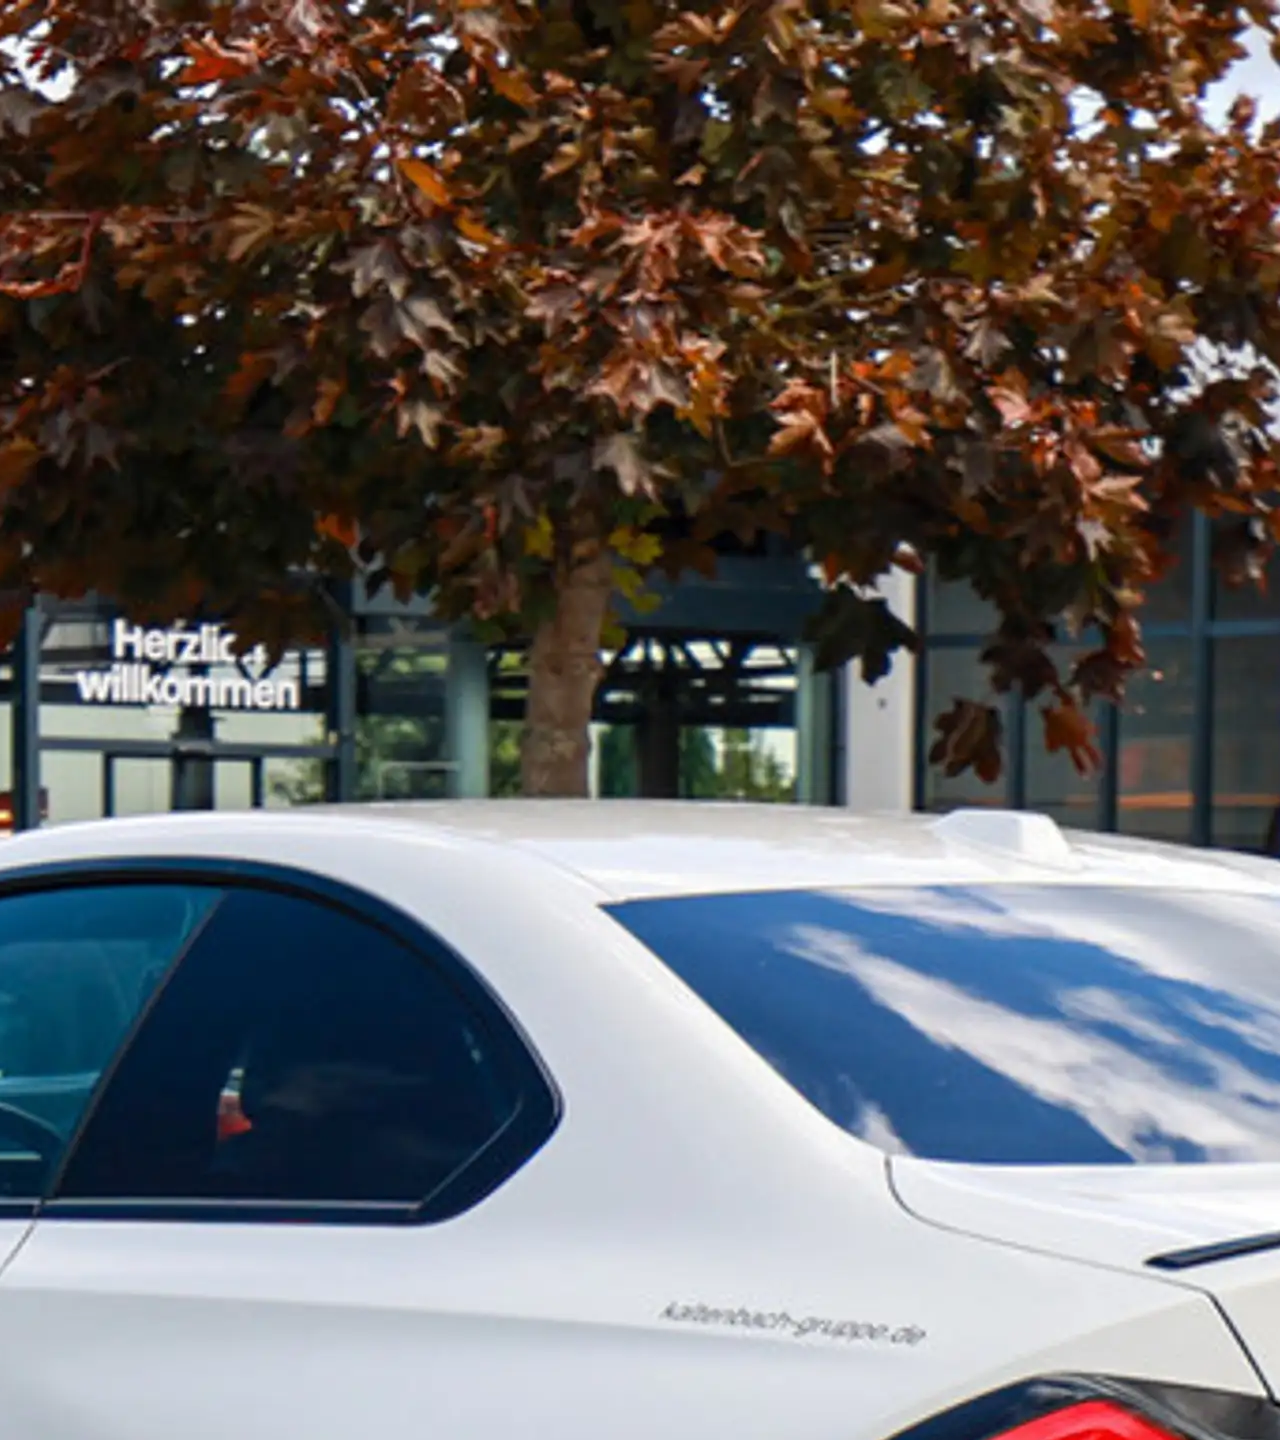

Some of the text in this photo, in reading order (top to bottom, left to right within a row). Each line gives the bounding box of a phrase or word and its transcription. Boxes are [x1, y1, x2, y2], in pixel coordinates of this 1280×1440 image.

[114, 617, 267, 663] Herzlic
[77, 664, 299, 709] willkommen
[659, 1301, 926, 1347] kaltenbach-gruppe.de
